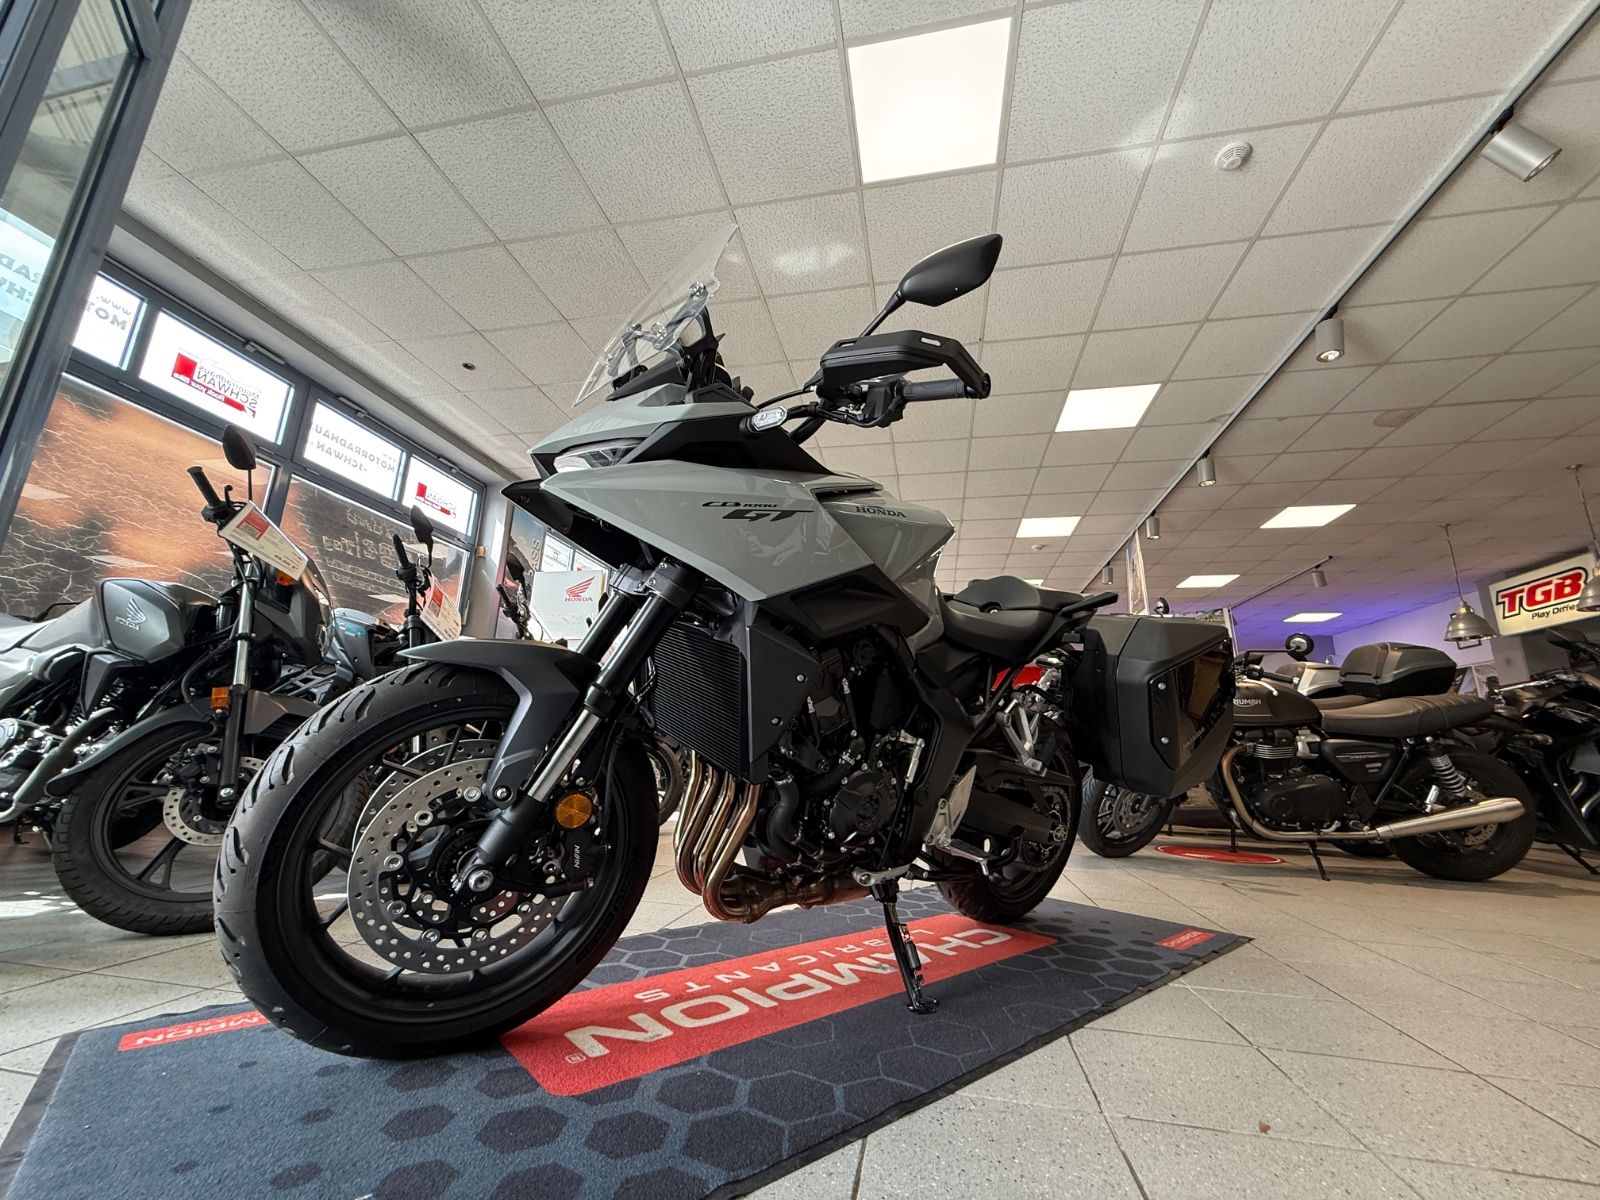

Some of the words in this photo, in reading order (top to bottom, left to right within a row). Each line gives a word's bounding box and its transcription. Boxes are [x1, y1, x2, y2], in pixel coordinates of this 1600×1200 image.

[722, 508, 814, 522] GT
[856, 505, 907, 519] HONDA
[1500, 571, 1583, 614] TGB
[1532, 610, 1551, 620] Play
[1232, 698, 1262, 706] RIUMPH
[634, 929, 934, 1003] LBRICANTS
[136, 1016, 260, 1045] MPION
